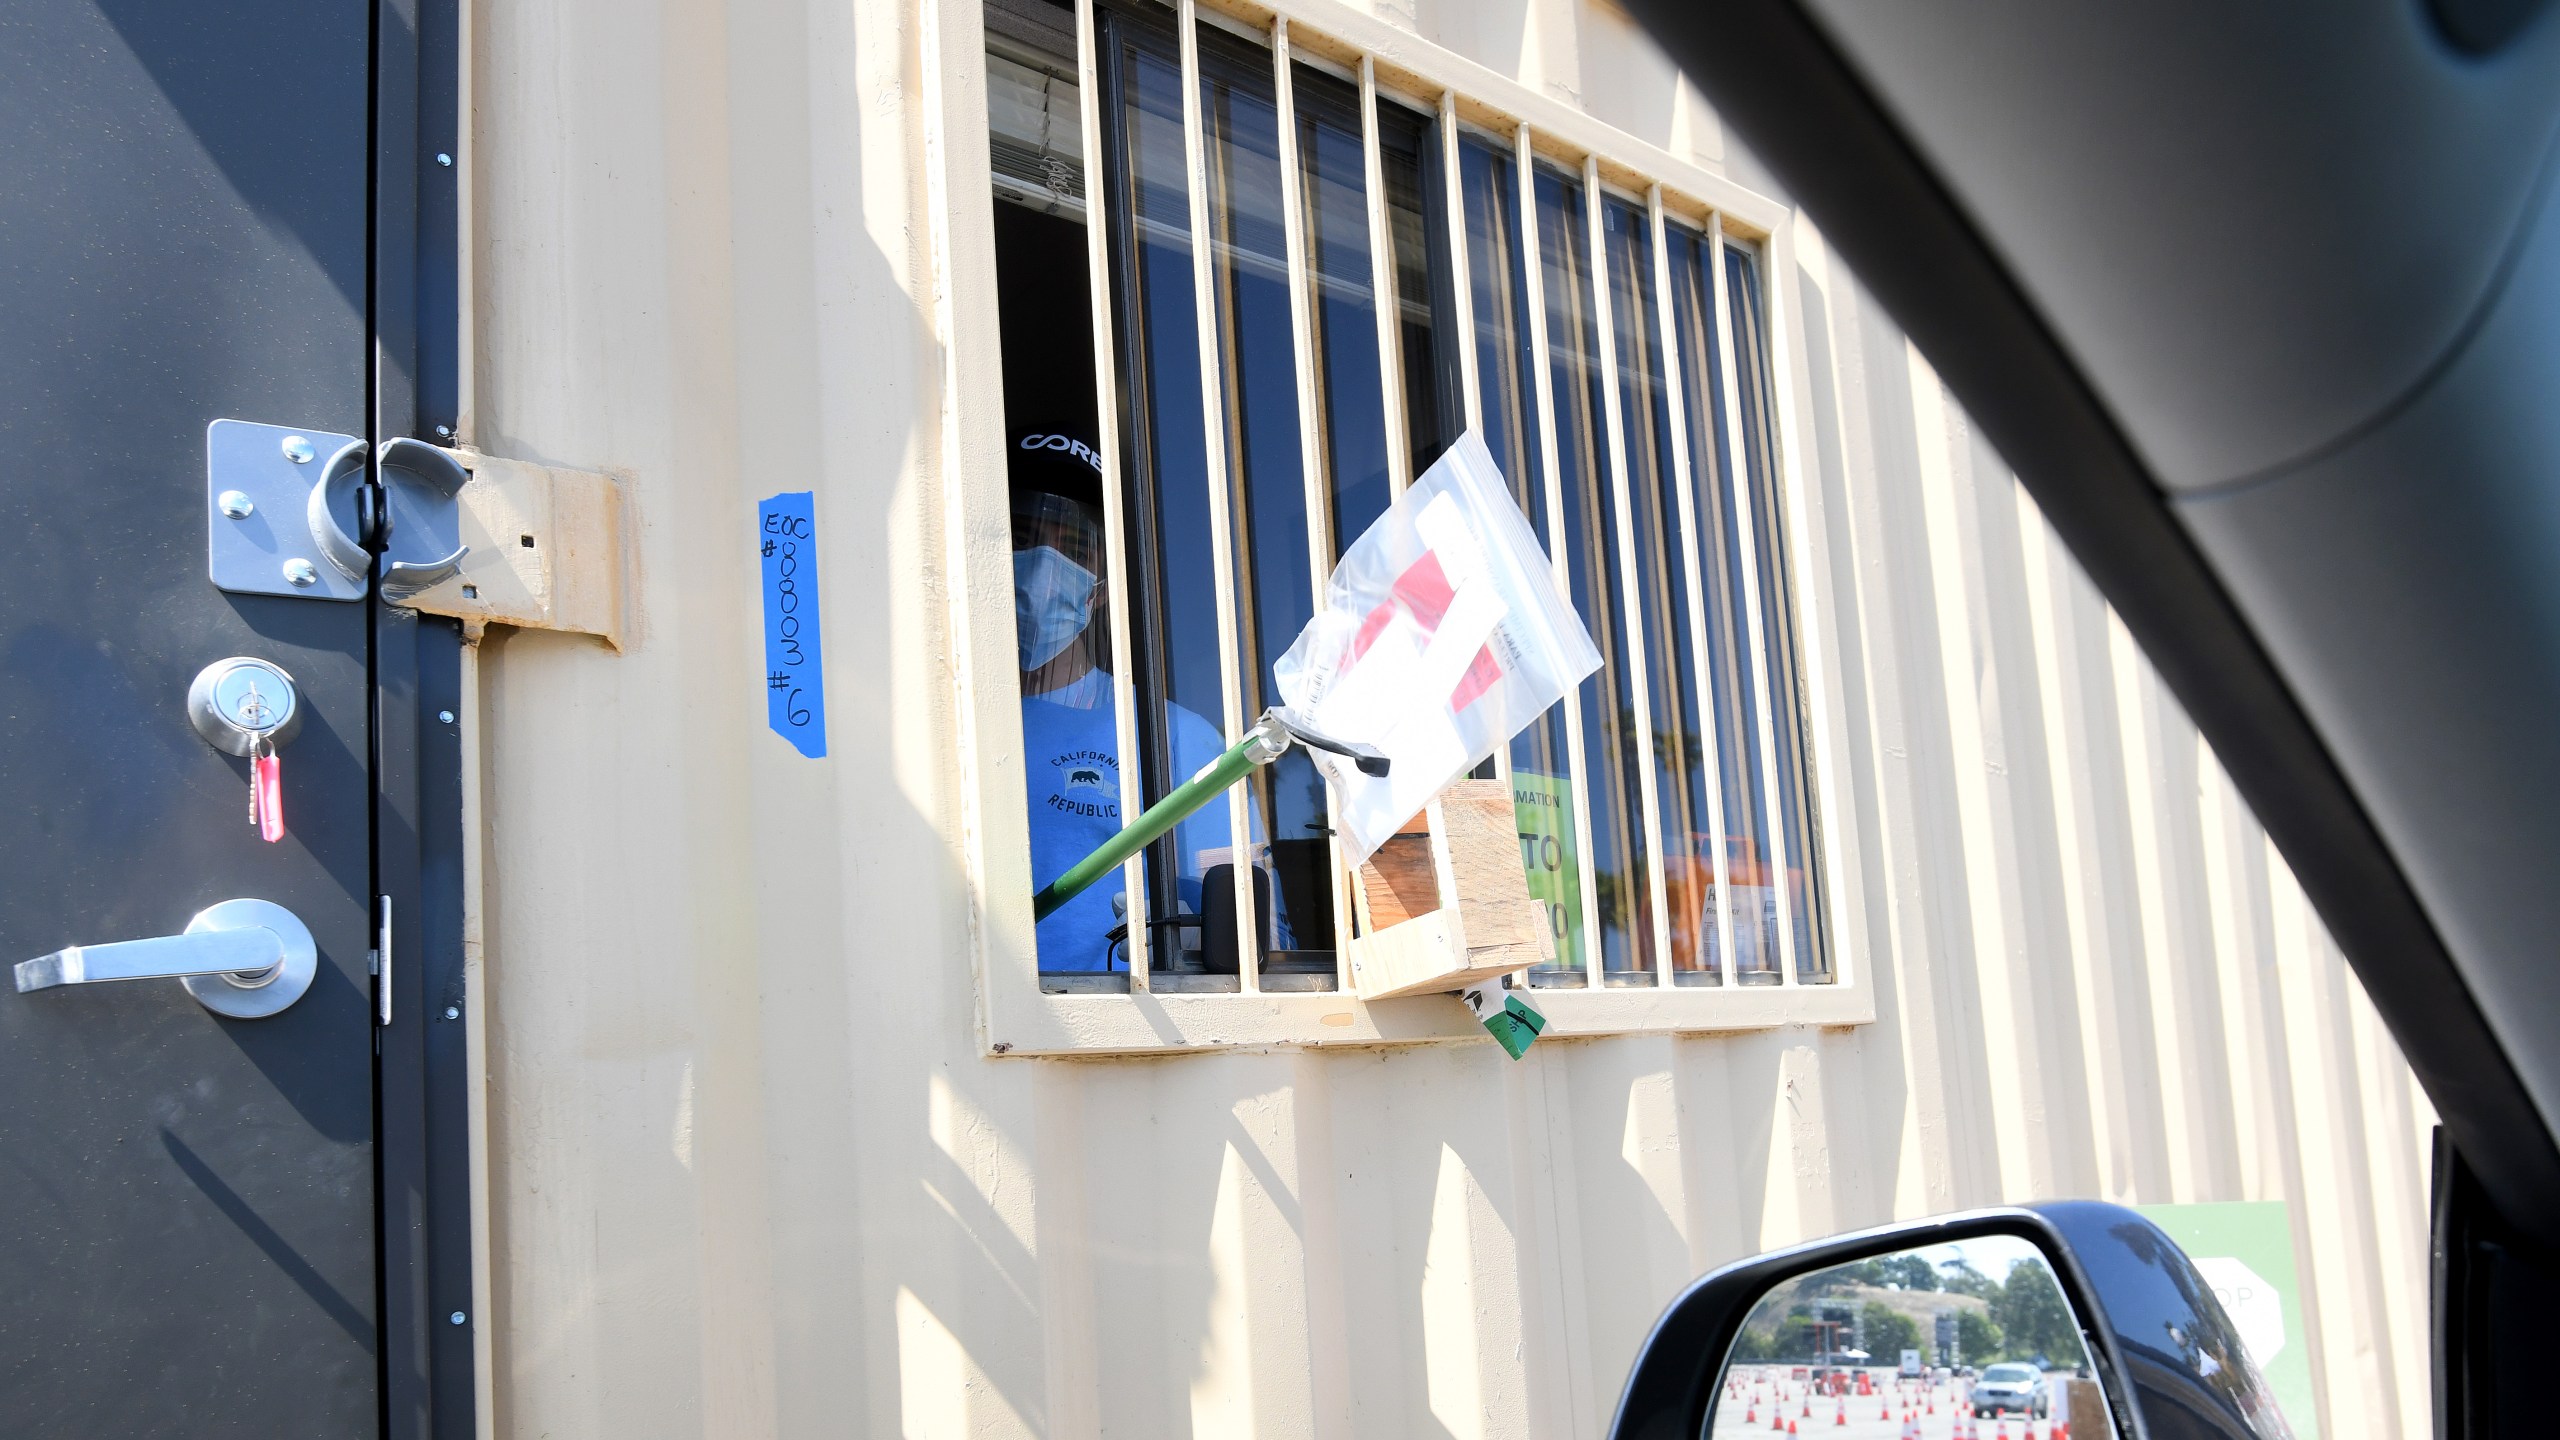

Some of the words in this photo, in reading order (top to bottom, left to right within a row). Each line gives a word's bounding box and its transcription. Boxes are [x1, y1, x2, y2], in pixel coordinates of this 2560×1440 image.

[764, 513, 809, 539] EOC
[1050, 750, 1119, 771] CALIFORNI
[1047, 793, 1118, 818] REPUBLIC
[1513, 789, 1560, 808] MATION
